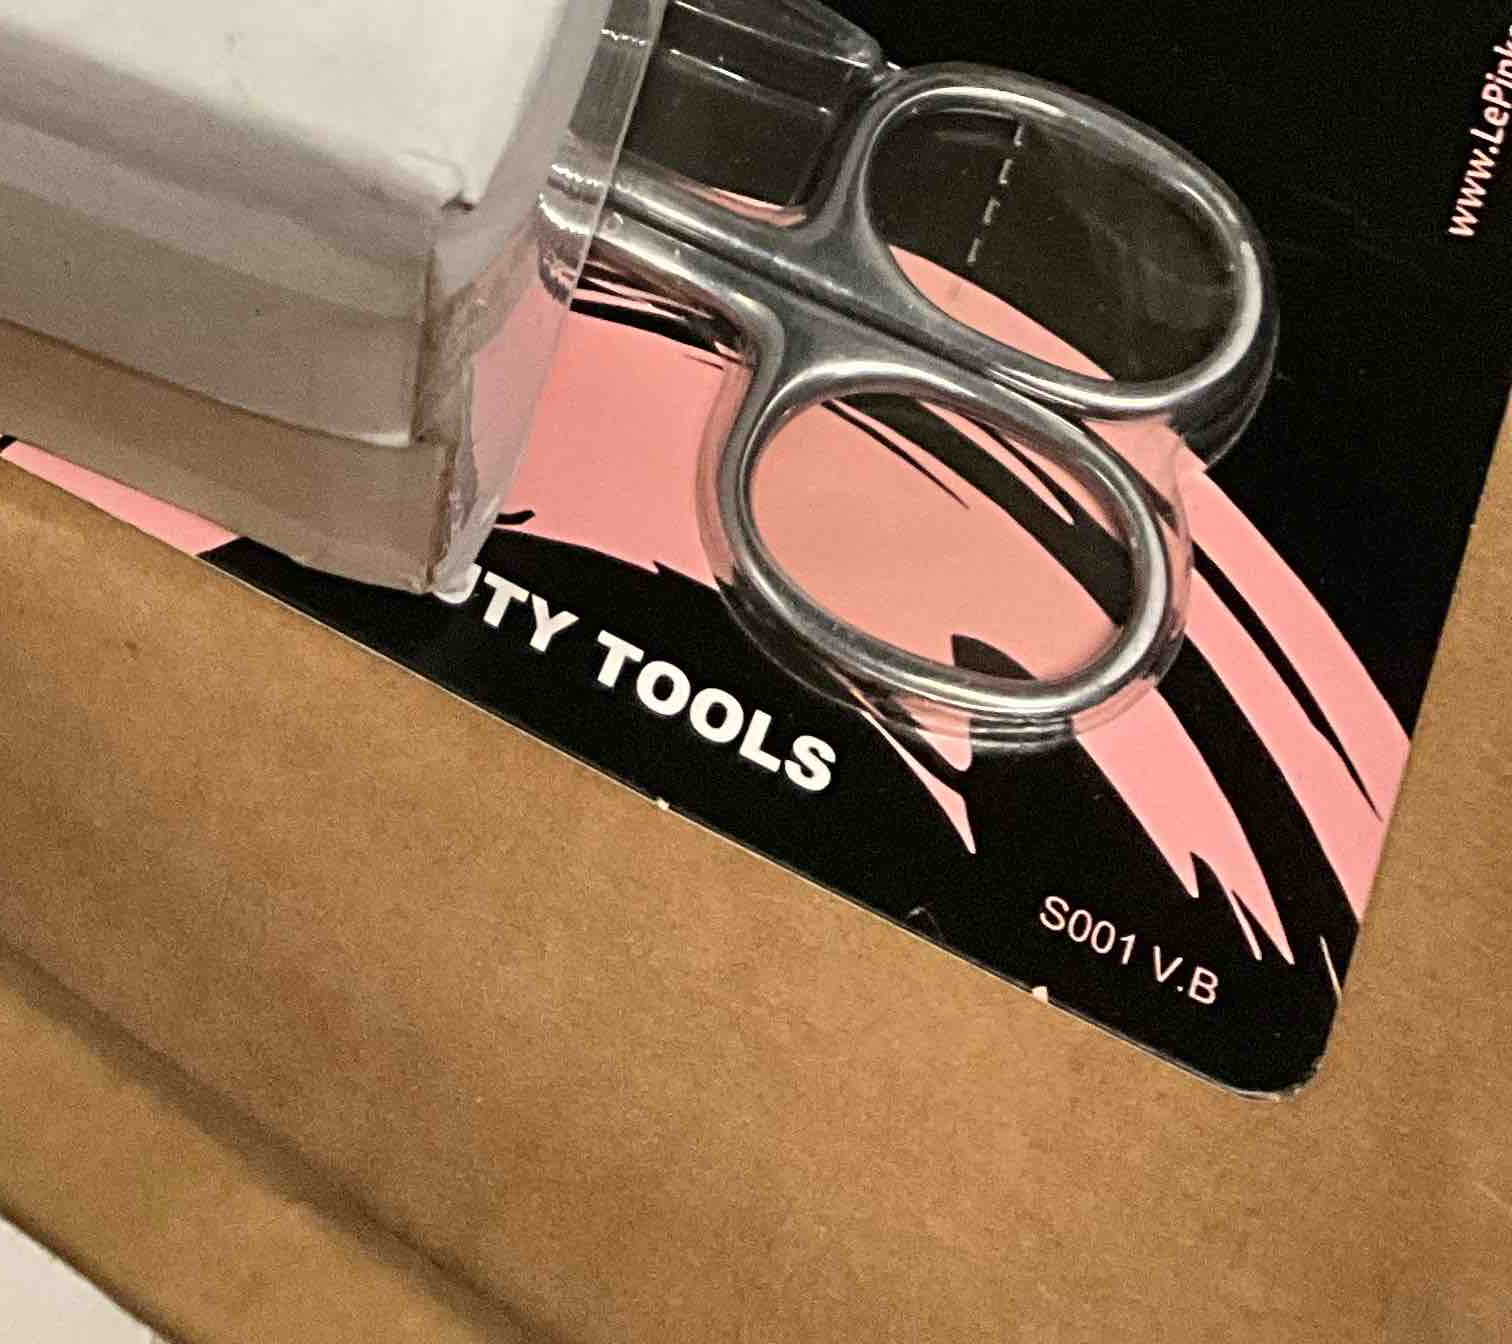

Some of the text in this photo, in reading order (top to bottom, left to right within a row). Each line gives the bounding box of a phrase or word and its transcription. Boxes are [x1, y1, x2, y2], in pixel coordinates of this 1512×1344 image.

[1447, 24, 1512, 238] www.LePink
[596, 628, 837, 793] TOOLS
[1038, 894, 1220, 1006] S001 V.B
